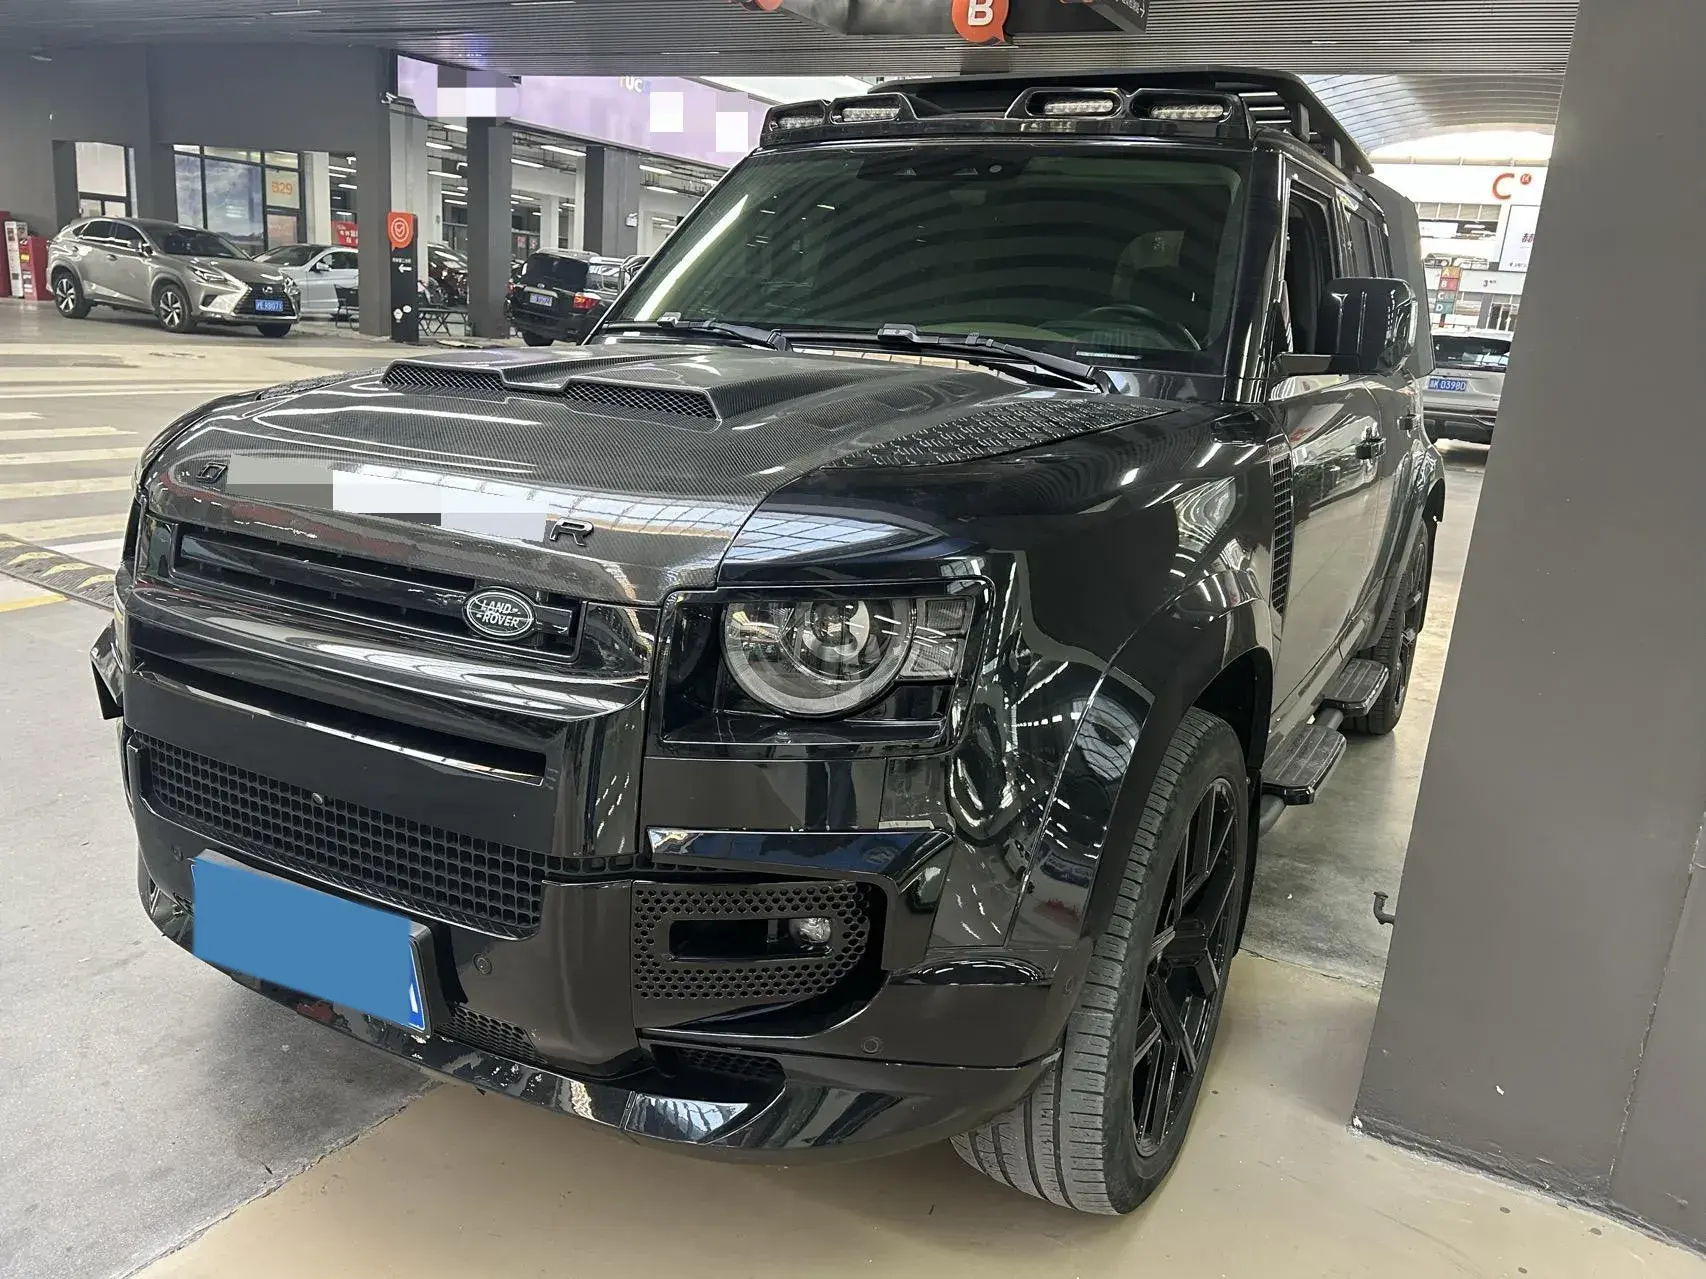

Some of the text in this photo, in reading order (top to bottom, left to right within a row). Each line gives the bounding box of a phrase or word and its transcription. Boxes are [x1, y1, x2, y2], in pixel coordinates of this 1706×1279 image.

[967, 0, 993, 26] B
[1493, 173, 1515, 200] C
[1441, 280, 1448, 288] B
[1435, 304, 1444, 312] D
[481, 600, 512, 613] LAND
[482, 613, 520, 629] ROVER
